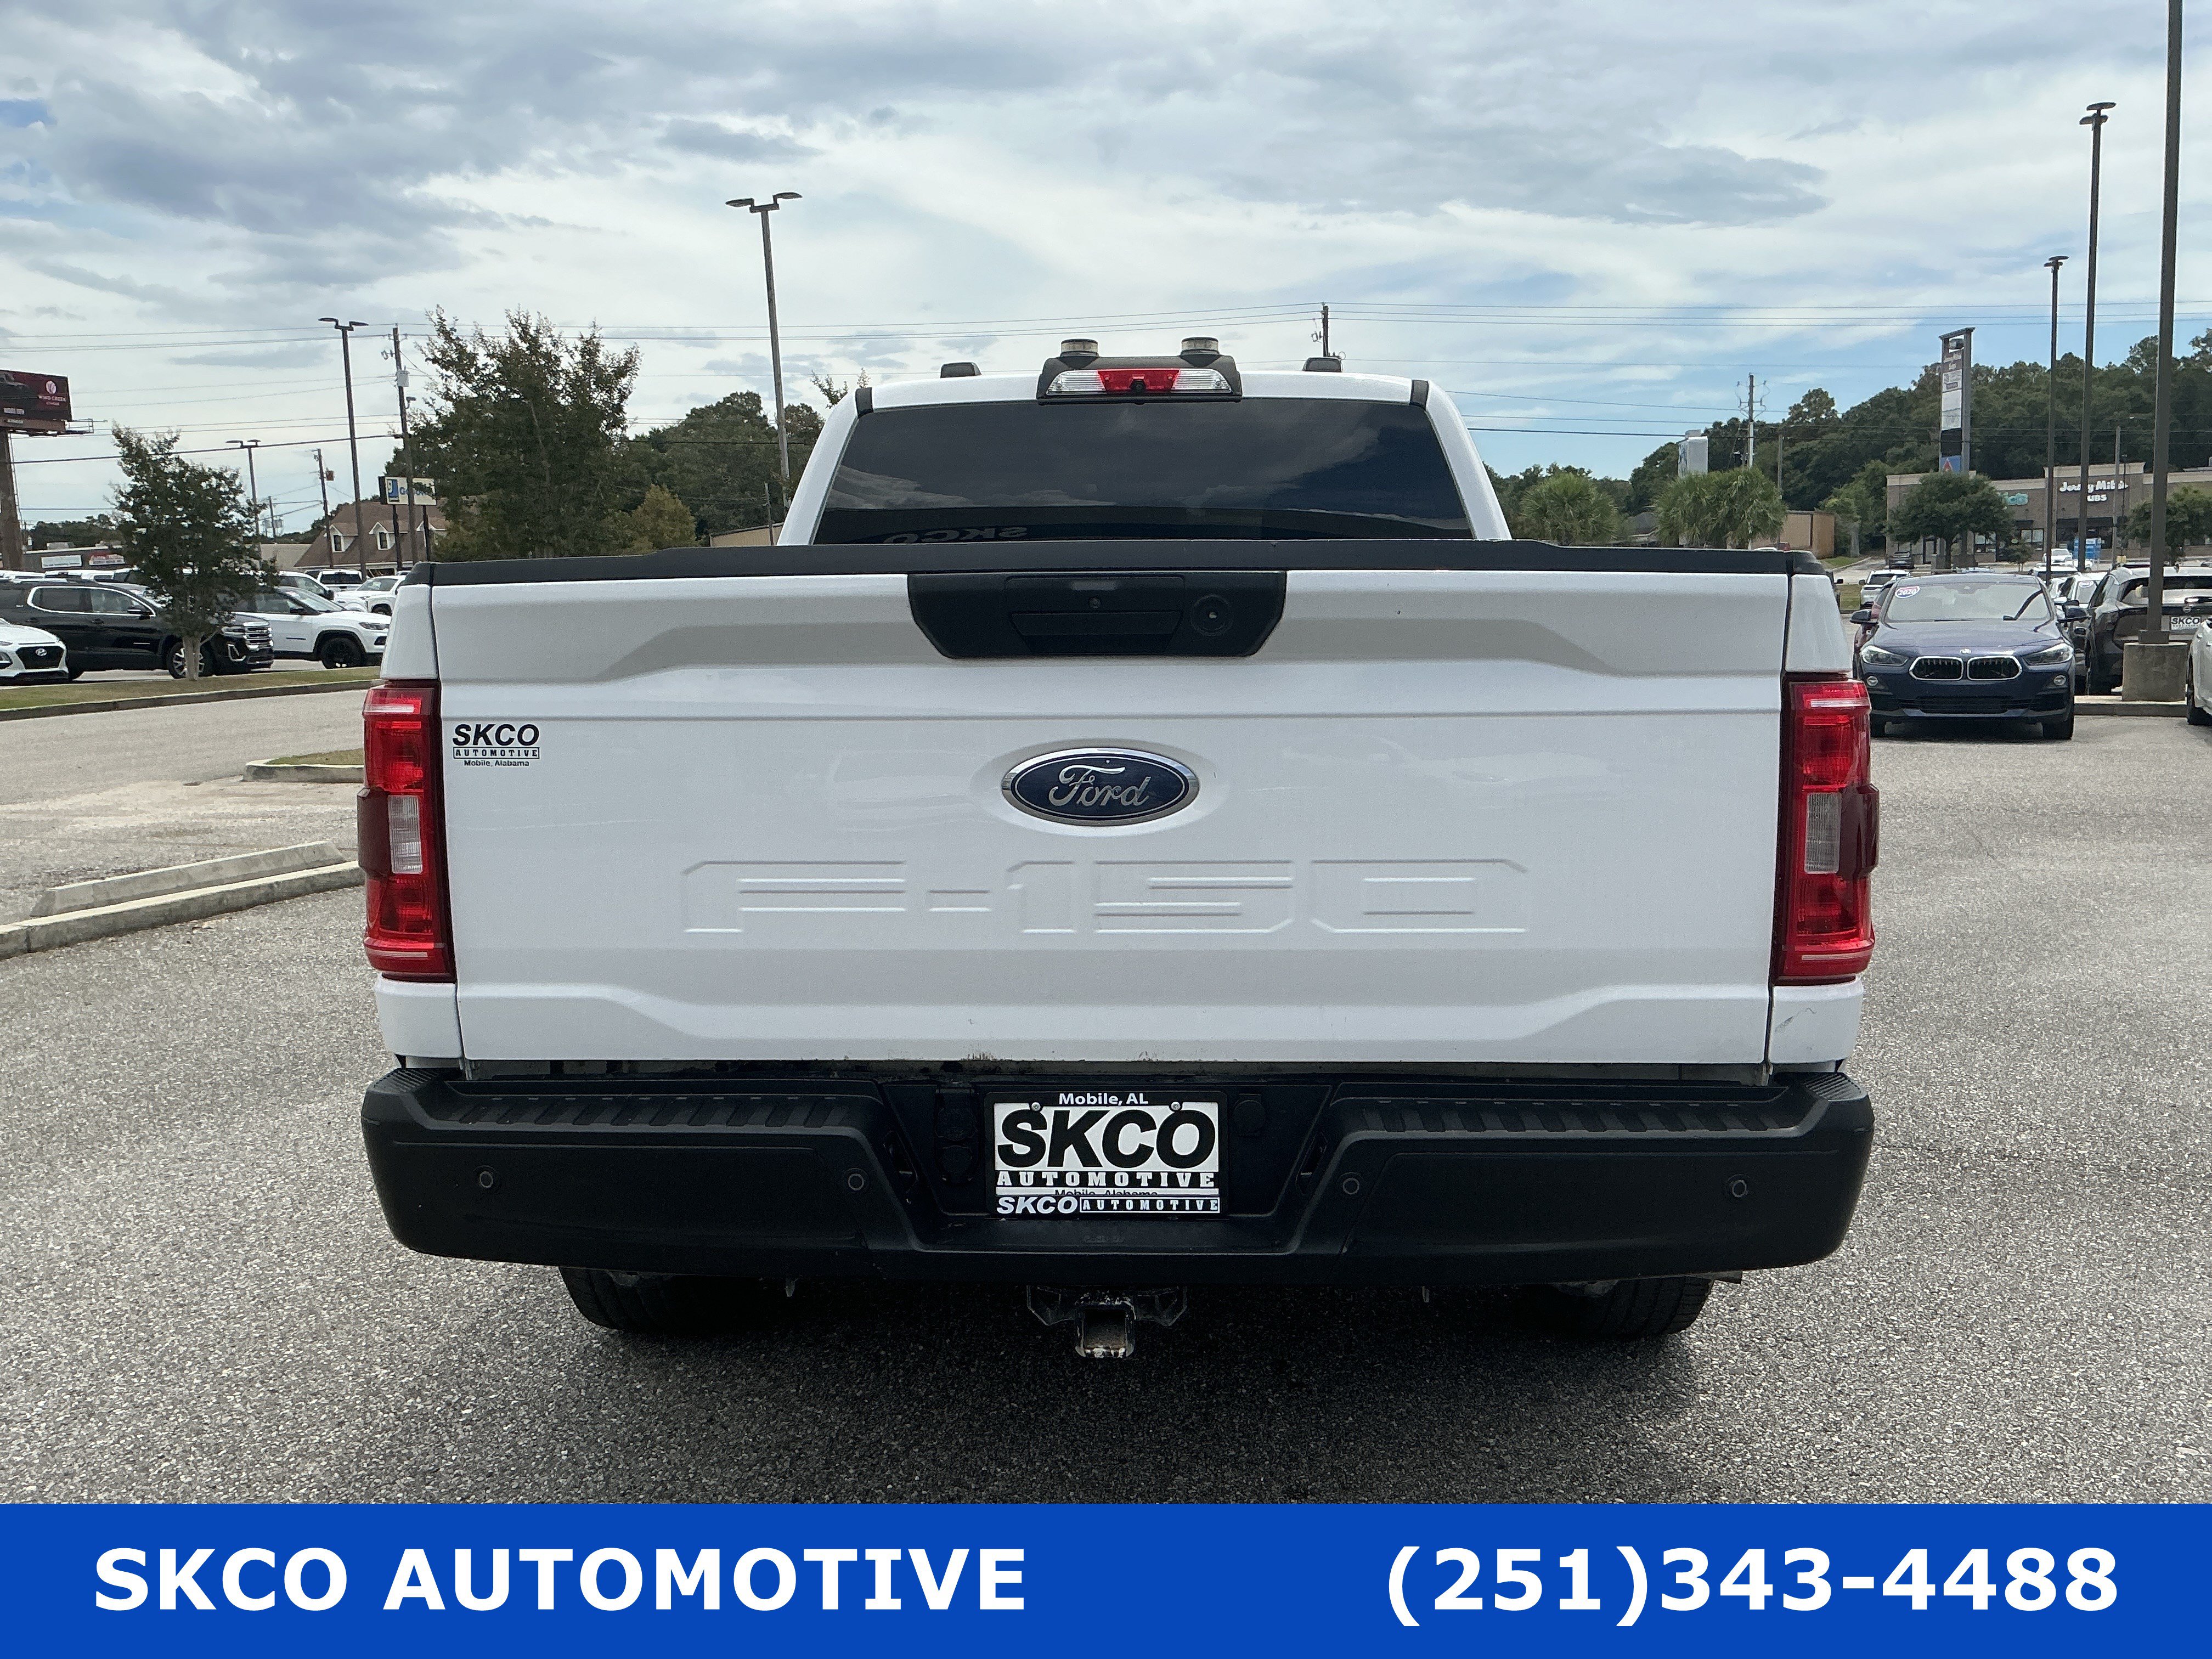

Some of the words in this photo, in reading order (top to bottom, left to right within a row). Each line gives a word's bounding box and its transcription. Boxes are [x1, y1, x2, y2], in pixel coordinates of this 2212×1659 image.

[2059, 482, 2094, 493] Jersy
[453, 724, 539, 746] SKCO
[1048, 765, 1152, 806] Ford
[682, 860, 1528, 934] F-150
[1059, 1092, 1122, 1107] Mobile,
[1126, 1093, 1149, 1105] AL
[997, 1109, 1216, 1169] SKCO
[997, 1171, 1215, 1187] AUTOMOTIVE
[997, 1196, 1078, 1214] SKCO
[1082, 1199, 1218, 1211] AUTOMOTIVE
